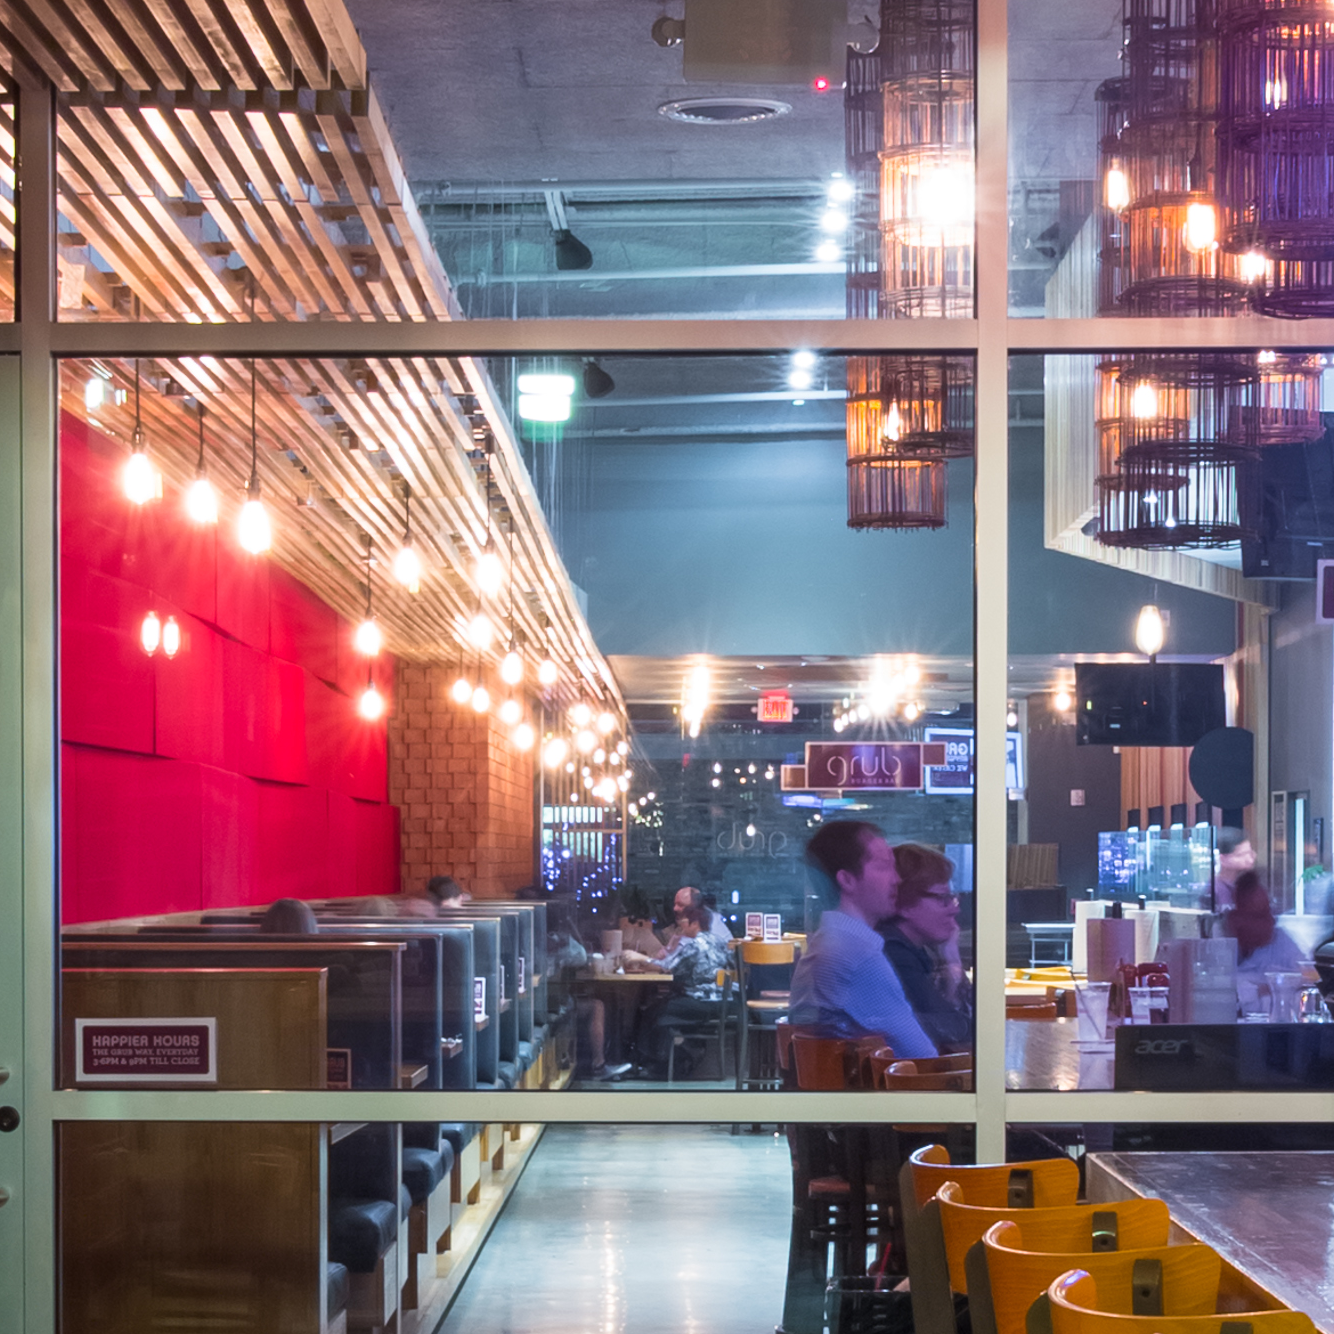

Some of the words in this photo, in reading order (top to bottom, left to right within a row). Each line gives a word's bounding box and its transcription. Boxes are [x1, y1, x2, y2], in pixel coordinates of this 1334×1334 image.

[827, 747, 901, 786] grub
[92, 1035, 149, 1047] HAPPIER
[153, 1035, 200, 1047] HOURS
[1134, 1039, 1189, 1055] acer
[92, 1048, 108, 1056] THE
[156, 1048, 199, 1056] EVERYDAY
[120, 1057, 127, 1065] &
[149, 1057, 169, 1065] TILL
[170, 1057, 200, 1065] CLOSE
